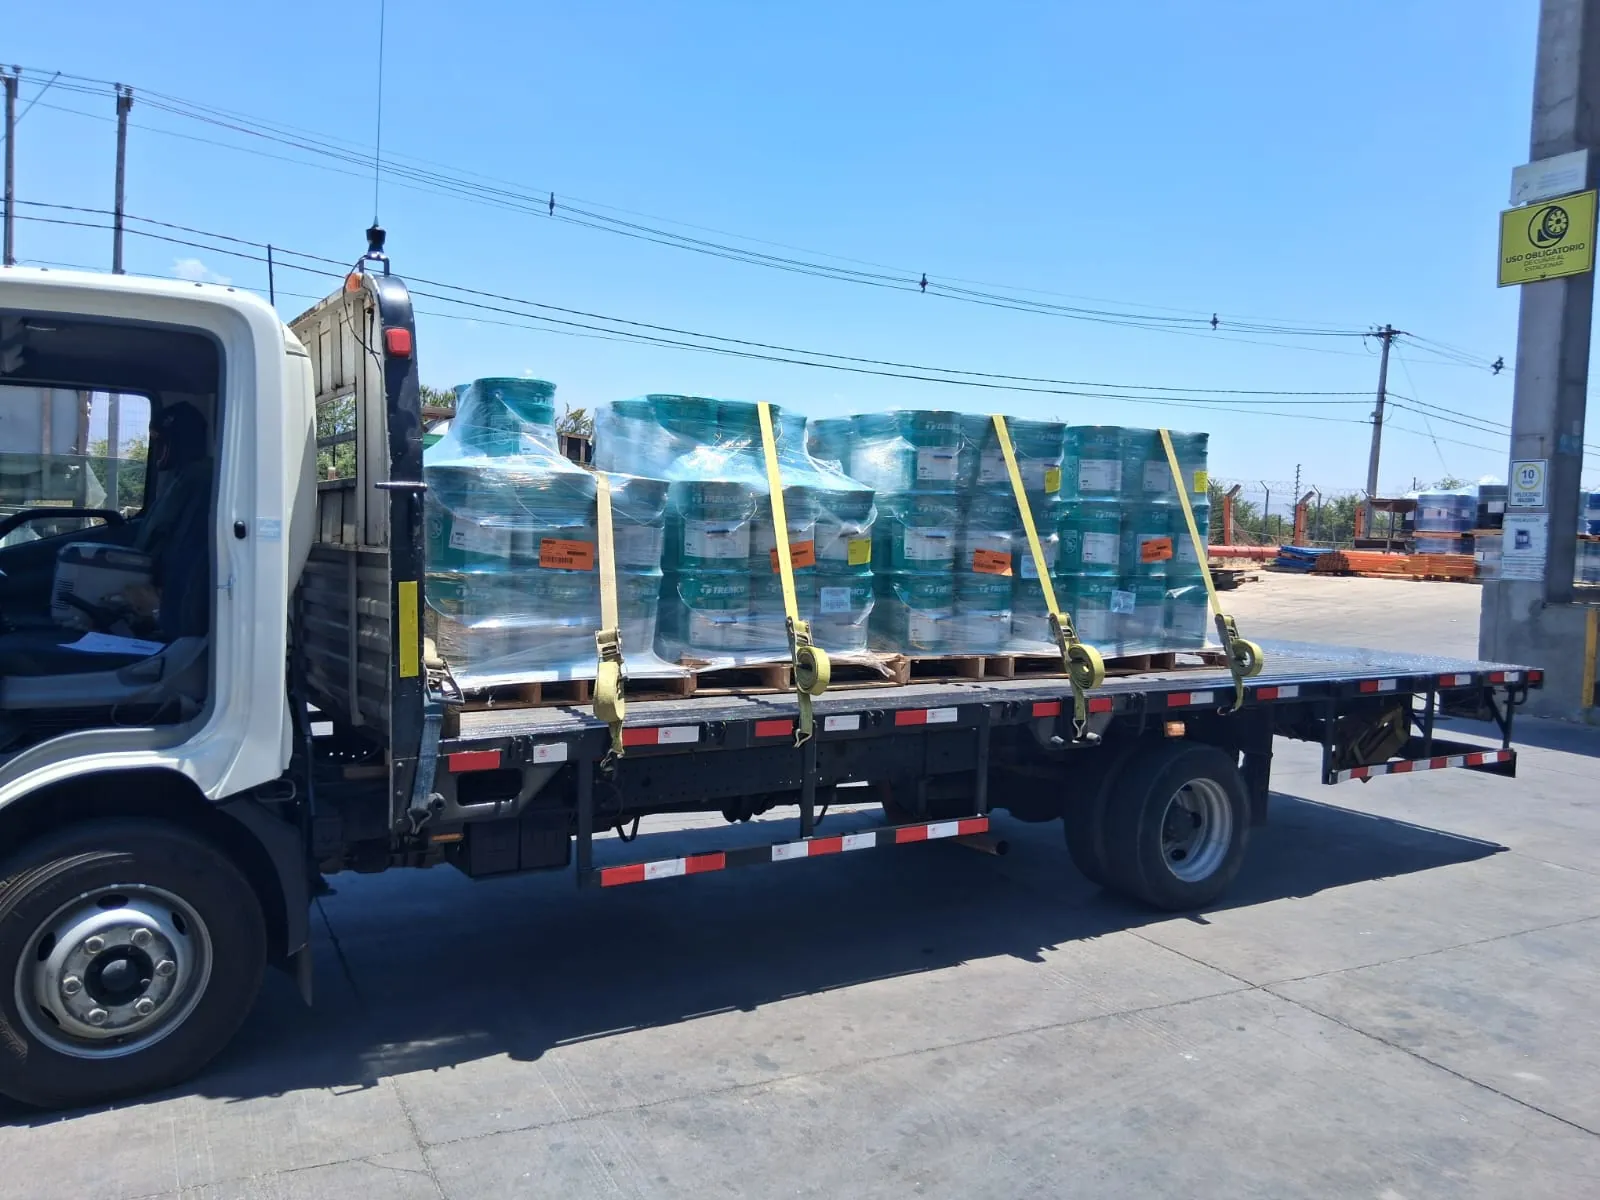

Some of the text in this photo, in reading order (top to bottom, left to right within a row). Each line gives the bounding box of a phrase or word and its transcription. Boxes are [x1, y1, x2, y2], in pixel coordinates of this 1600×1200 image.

[1505, 243, 1585, 264] USO OBLIGATORIO
[1521, 469, 1535, 479] 10
[713, 584, 745, 594] TREMCO
